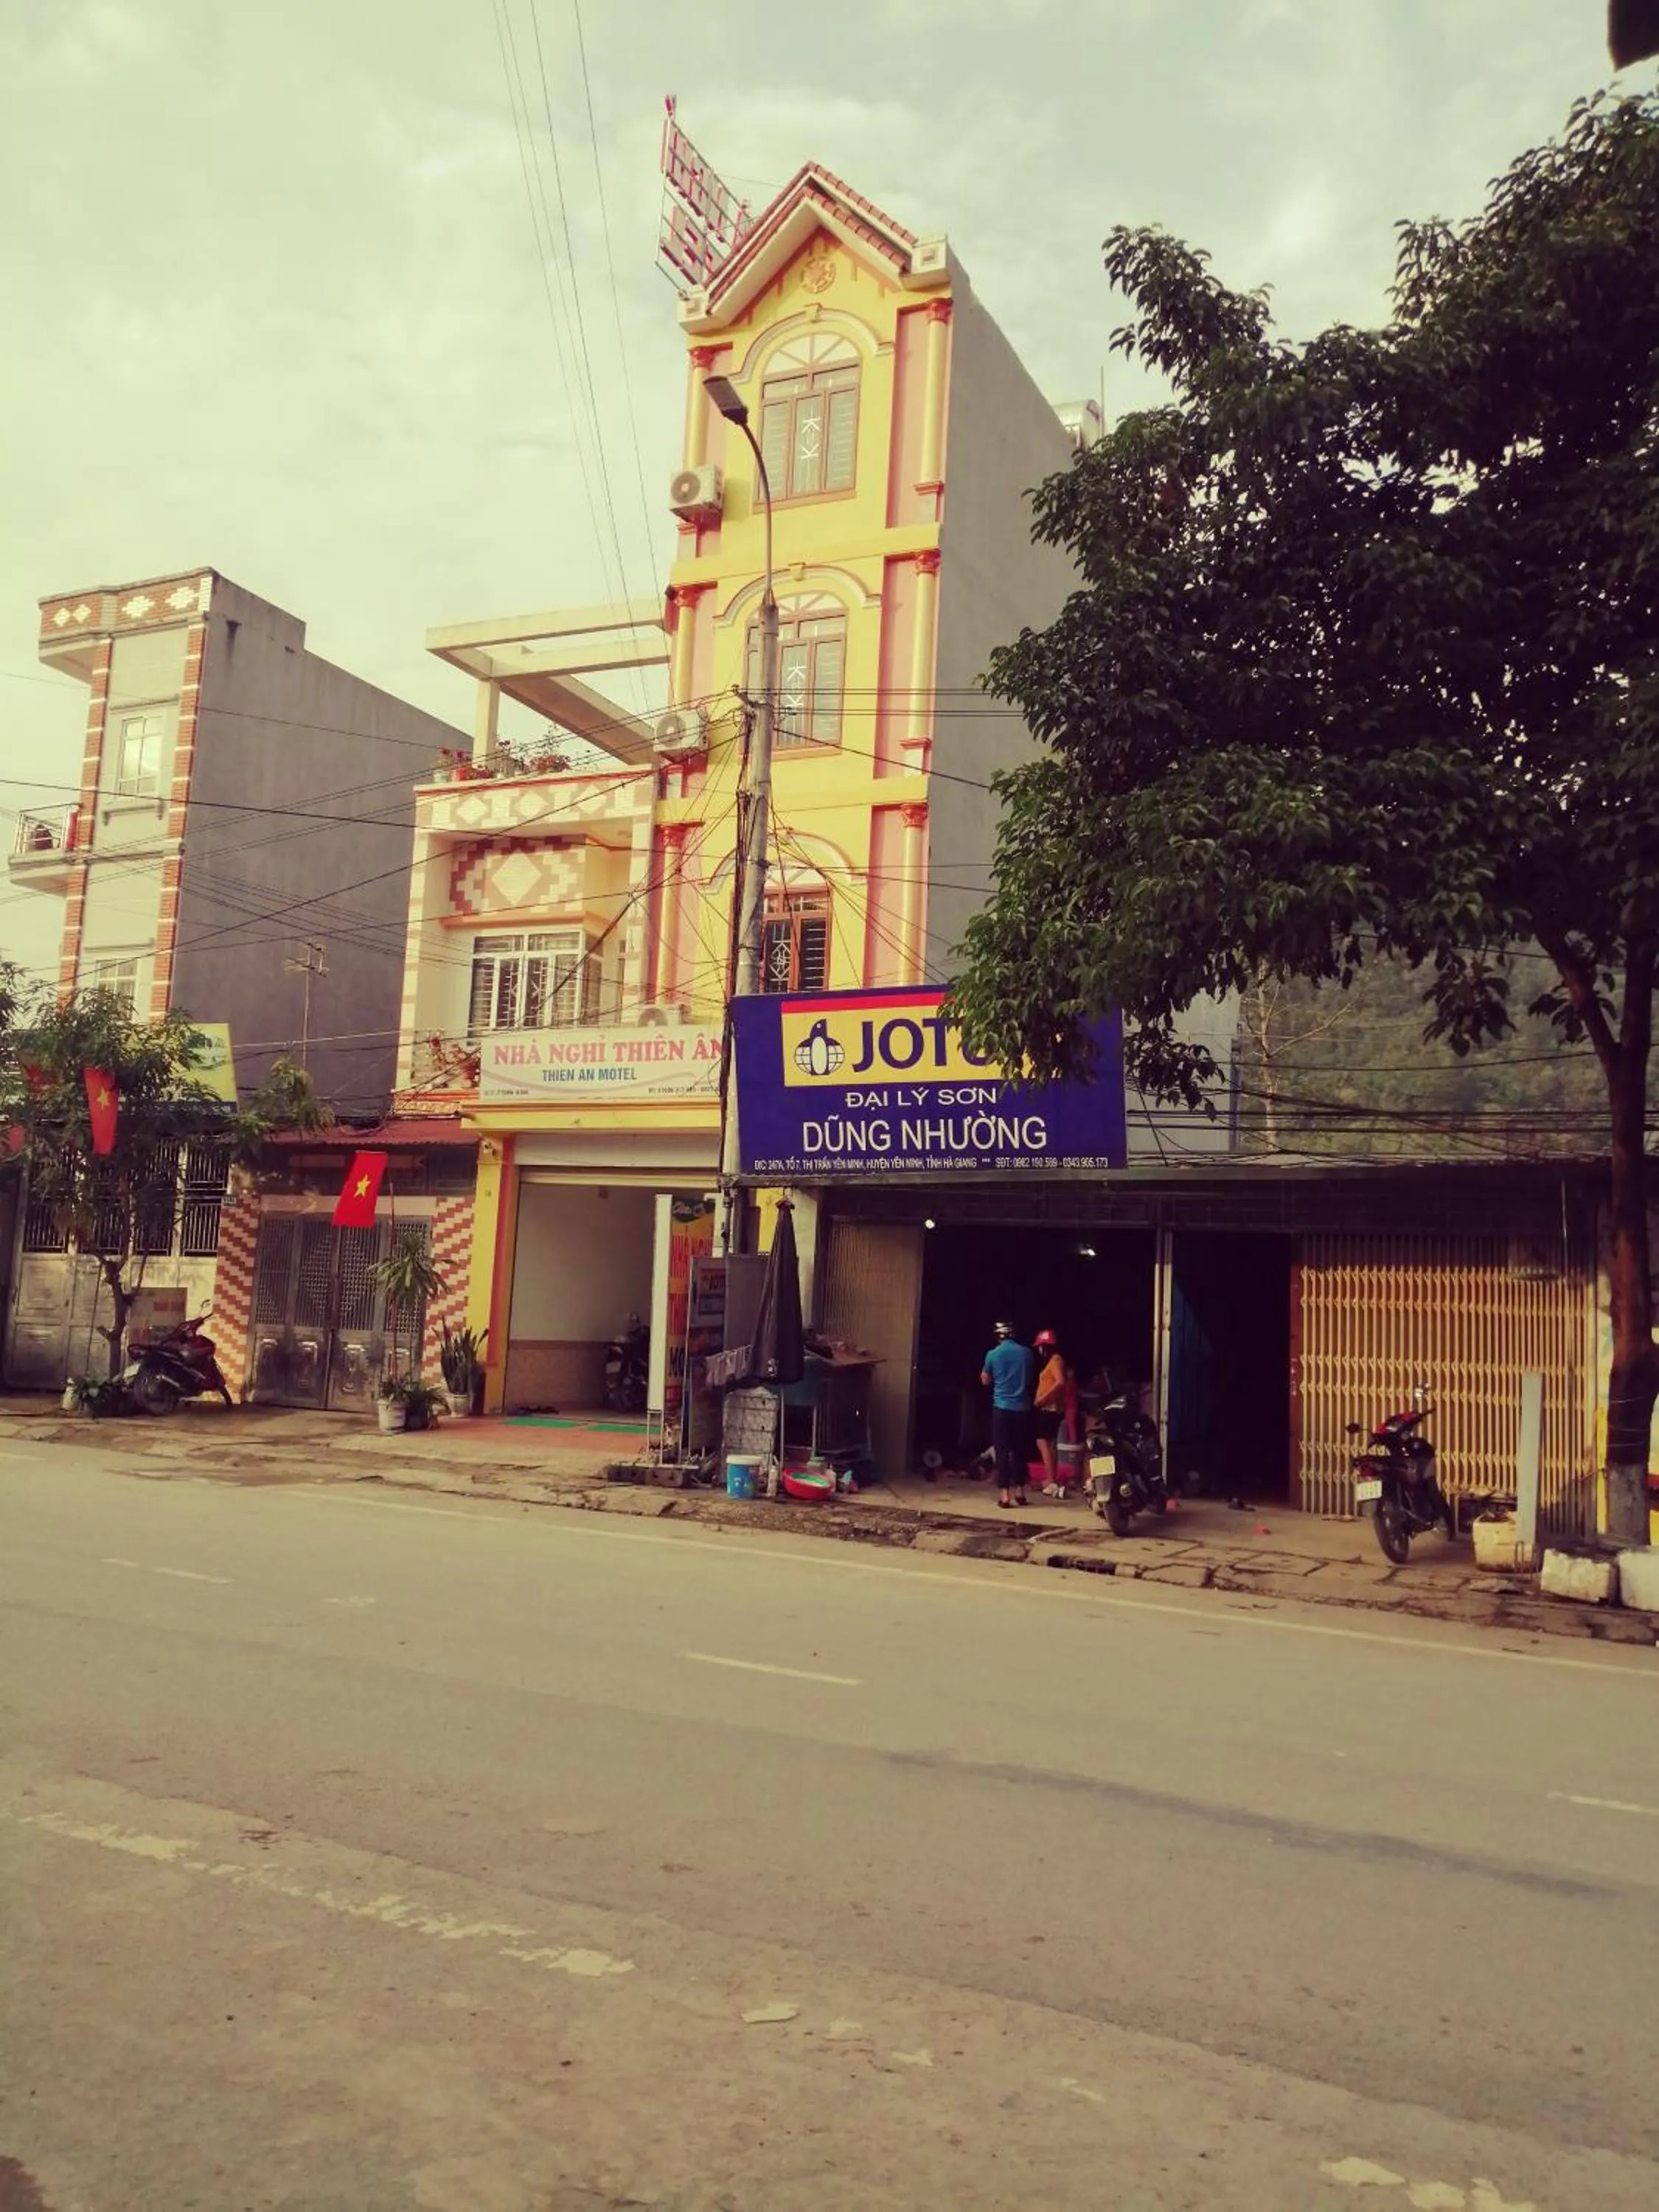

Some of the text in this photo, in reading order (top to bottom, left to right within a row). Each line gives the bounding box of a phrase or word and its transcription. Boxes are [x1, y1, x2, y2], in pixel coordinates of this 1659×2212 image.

[613, 1034, 685, 1062] THIÊN
[542, 1067, 637, 1082] THIEN AN MOTEL
[845, 1086, 998, 1111] ĐẠI LÝ SƠN
[802, 1109, 1048, 1152] DŨNG NHƯỜNG
